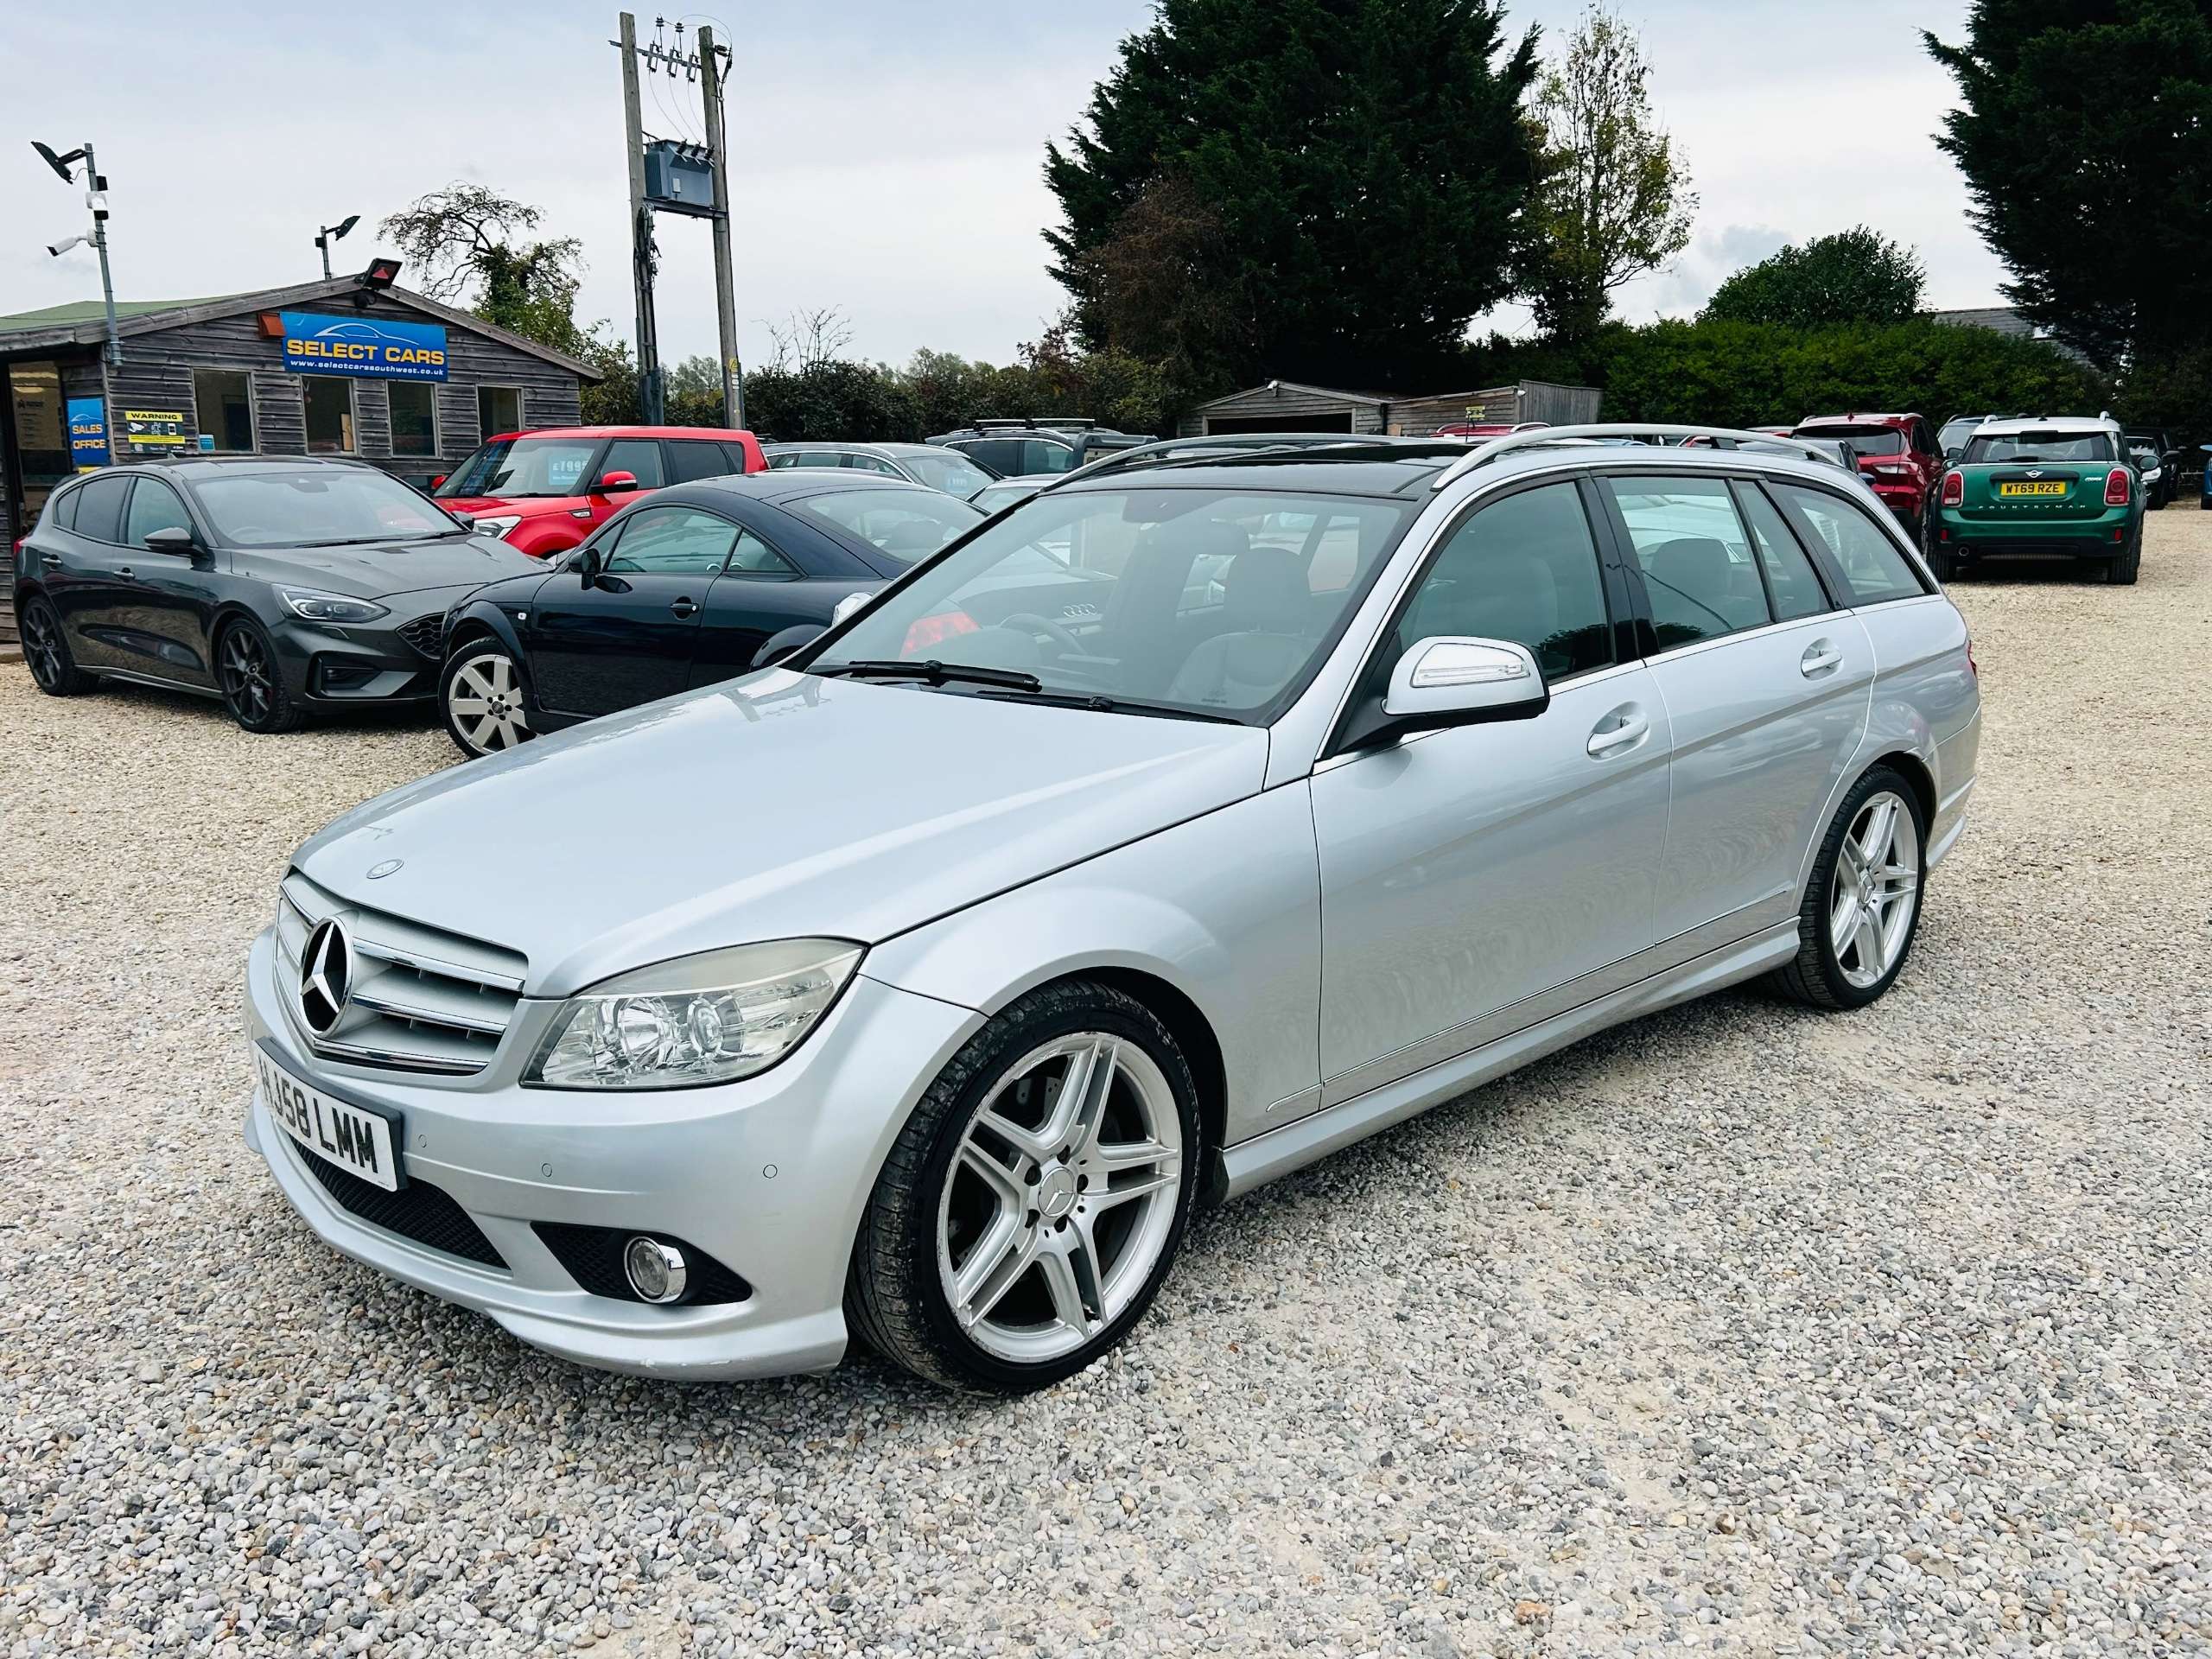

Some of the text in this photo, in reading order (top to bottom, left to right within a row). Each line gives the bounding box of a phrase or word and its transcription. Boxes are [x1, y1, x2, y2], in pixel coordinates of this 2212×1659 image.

[287, 340, 445, 365] SELECT CARS
[290, 359, 444, 376] www.selectcarssouthwest.co.uk
[72, 423, 103, 435] SALES
[73, 439, 106, 449] OFFICE
[2005, 483, 2060, 493] WT69 RZE
[258, 1054, 378, 1174] HJ58 LMM
